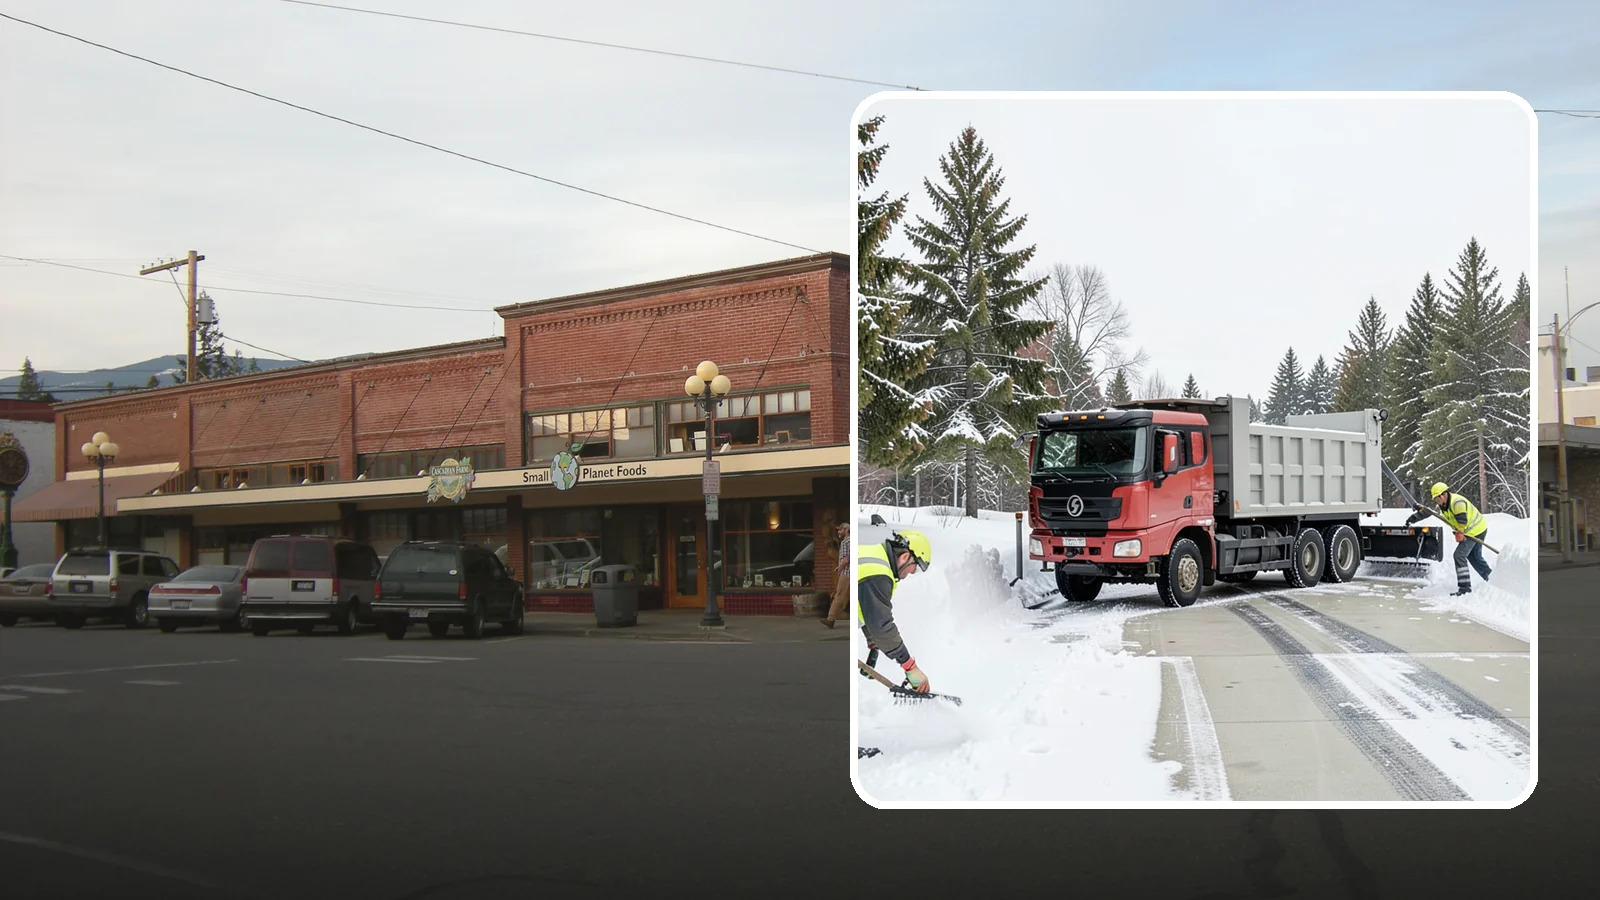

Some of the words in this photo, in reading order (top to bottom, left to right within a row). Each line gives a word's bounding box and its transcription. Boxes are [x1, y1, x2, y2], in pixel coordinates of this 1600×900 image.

[523, 471, 549, 483] Small
[583, 467, 614, 479] Planet
[617, 465, 647, 477] Foods
